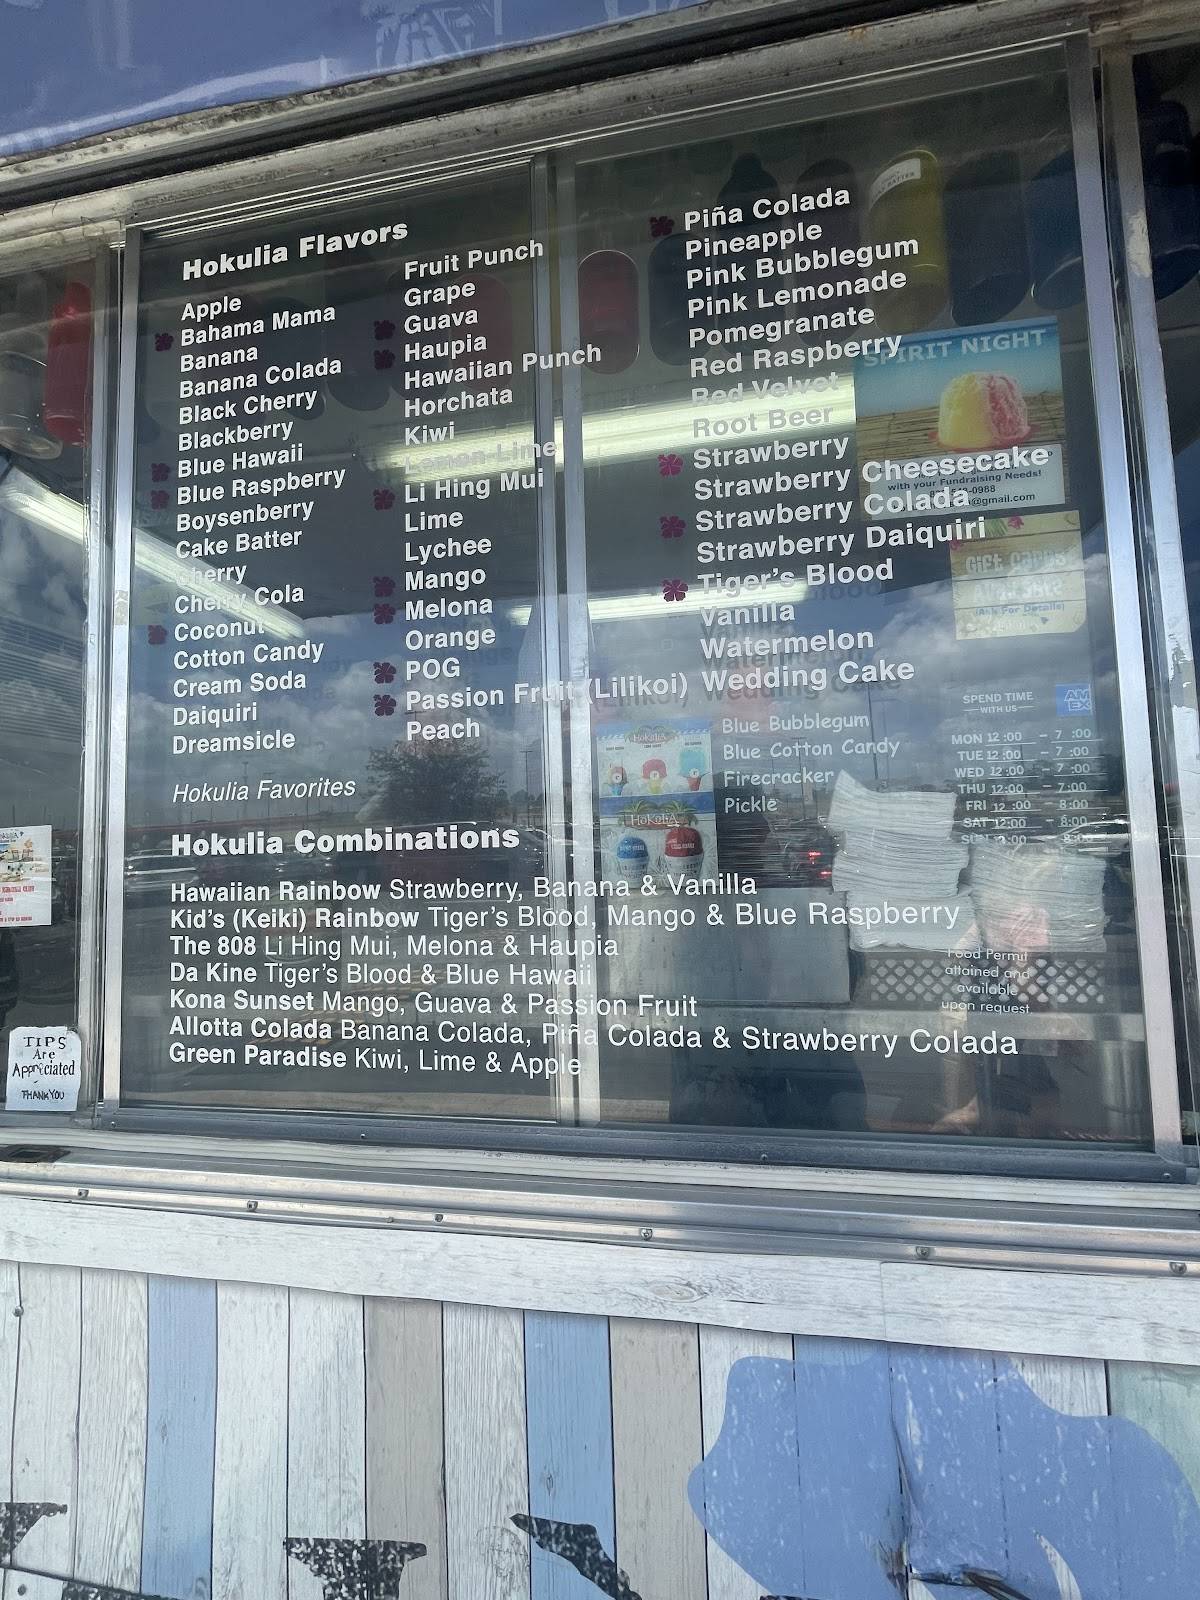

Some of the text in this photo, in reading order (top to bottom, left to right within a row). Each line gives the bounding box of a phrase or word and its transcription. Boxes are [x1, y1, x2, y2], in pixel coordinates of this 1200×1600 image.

[684, 187, 850, 231] Piña Colada
[183, 222, 408, 280] Hokulia Flavors
[685, 222, 822, 260] Pineapple
[404, 239, 543, 280] Fruit Punch
[687, 239, 919, 289] Pink Bubblegum
[404, 281, 476, 307] Grape
[688, 270, 907, 319] Pink Lemonade
[181, 296, 242, 322] Apple
[404, 309, 478, 334] Guava
[181, 306, 335, 346] Bahama Mama
[689, 306, 875, 348] Pomegranate
[404, 334, 487, 362] Haupia
[962, 329, 1047, 354] NIGHT
[180, 346, 258, 372] Banana
[404, 343, 601, 390] Hawaiian Punch
[690, 335, 902, 377] Red Raspberry
[179, 357, 342, 398] Banana Colada
[179, 390, 317, 425] Black Cherry
[404, 387, 513, 418] Horchata
[404, 421, 455, 446] Kiwi
[693, 406, 833, 438] Root Beer
[178, 421, 293, 451] Blackberry
[177, 443, 303, 478] Blue Hawaii
[693, 437, 849, 469] Strawberry
[405, 468, 544, 503] Li Hing Mui
[695, 468, 851, 500] Strawberry
[862, 446, 1049, 483] Cheesecake
[887, 469, 1042, 491] with your Fundraising Needs!
[177, 469, 346, 505] Blue Raspberry
[176, 501, 314, 532] Boysenberry
[405, 511, 463, 532] Lime
[695, 500, 853, 532] Strawberry
[864, 487, 970, 515] Colada
[176, 530, 302, 559] Cake Batter
[405, 538, 492, 565] Lychee
[697, 517, 986, 564] Strawberry Daiquiri
[405, 568, 486, 591] Mango
[807, 558, 894, 586] Blood
[254, 585, 304, 606] Cola
[405, 598, 493, 621] Melona
[700, 602, 795, 627] Vanilla
[174, 618, 265, 642] Coconut
[405, 628, 496, 651] Orange
[173, 640, 324, 670] Cotton Candy
[700, 629, 874, 659] Watermelon
[406, 657, 460, 681] POG
[702, 659, 915, 692] Wedding Cake
[173, 671, 306, 698] Cream Soda
[407, 672, 688, 711] Passion (Lilikoi)
[963, 692, 1033, 704] SPEND TIME
[173, 702, 257, 728] Daiquiri
[980, 705, 1017, 714] WITH US
[407, 718, 480, 741] Peach
[722, 713, 870, 734] Blue Bubblegum
[173, 729, 296, 754] Dreamsicle
[723, 737, 900, 760] Blue Cotton Candy
[951, 734, 983, 745] MON
[958, 751, 983, 761] TUE
[724, 768, 833, 787] Firecracker
[954, 767, 985, 778] WED
[172, 777, 356, 803] Hokulia Favorites
[958, 784, 1024, 794] THU 12:00
[724, 797, 778, 814] Pickle
[966, 801, 986, 811] FRI
[172, 825, 520, 856] Hokulia Combinations
[171, 873, 757, 902] Hawaiian Rainbow Strawberry, Banana Vanilla
[233, 901, 959, 933] (Keiki) Rainbow Blood, Mango Blue Raspberry
[170, 934, 618, 961] The 808 Li Hing Mui, Melona Haupia
[987, 948, 1028, 961] Permit
[170, 962, 591, 985] Da Kine Blood Blue Hawaii
[945, 965, 1030, 979] attained and
[170, 989, 697, 1017] Kona Sunset Mango, Guava Passion Fruit
[957, 983, 1018, 996] available
[941, 1001, 975, 1011] upon
[23, 1036, 66, 1049] TIPS
[170, 1016, 1019, 1058] Allotta Colada Banana Colada, Colada Strawberry Colada
[33, 1049, 55, 1059] Are
[170, 1042, 581, 1078] Green Paradise Kiwi, Lime Apple
[21, 1089, 65, 1100] THANK YOU
